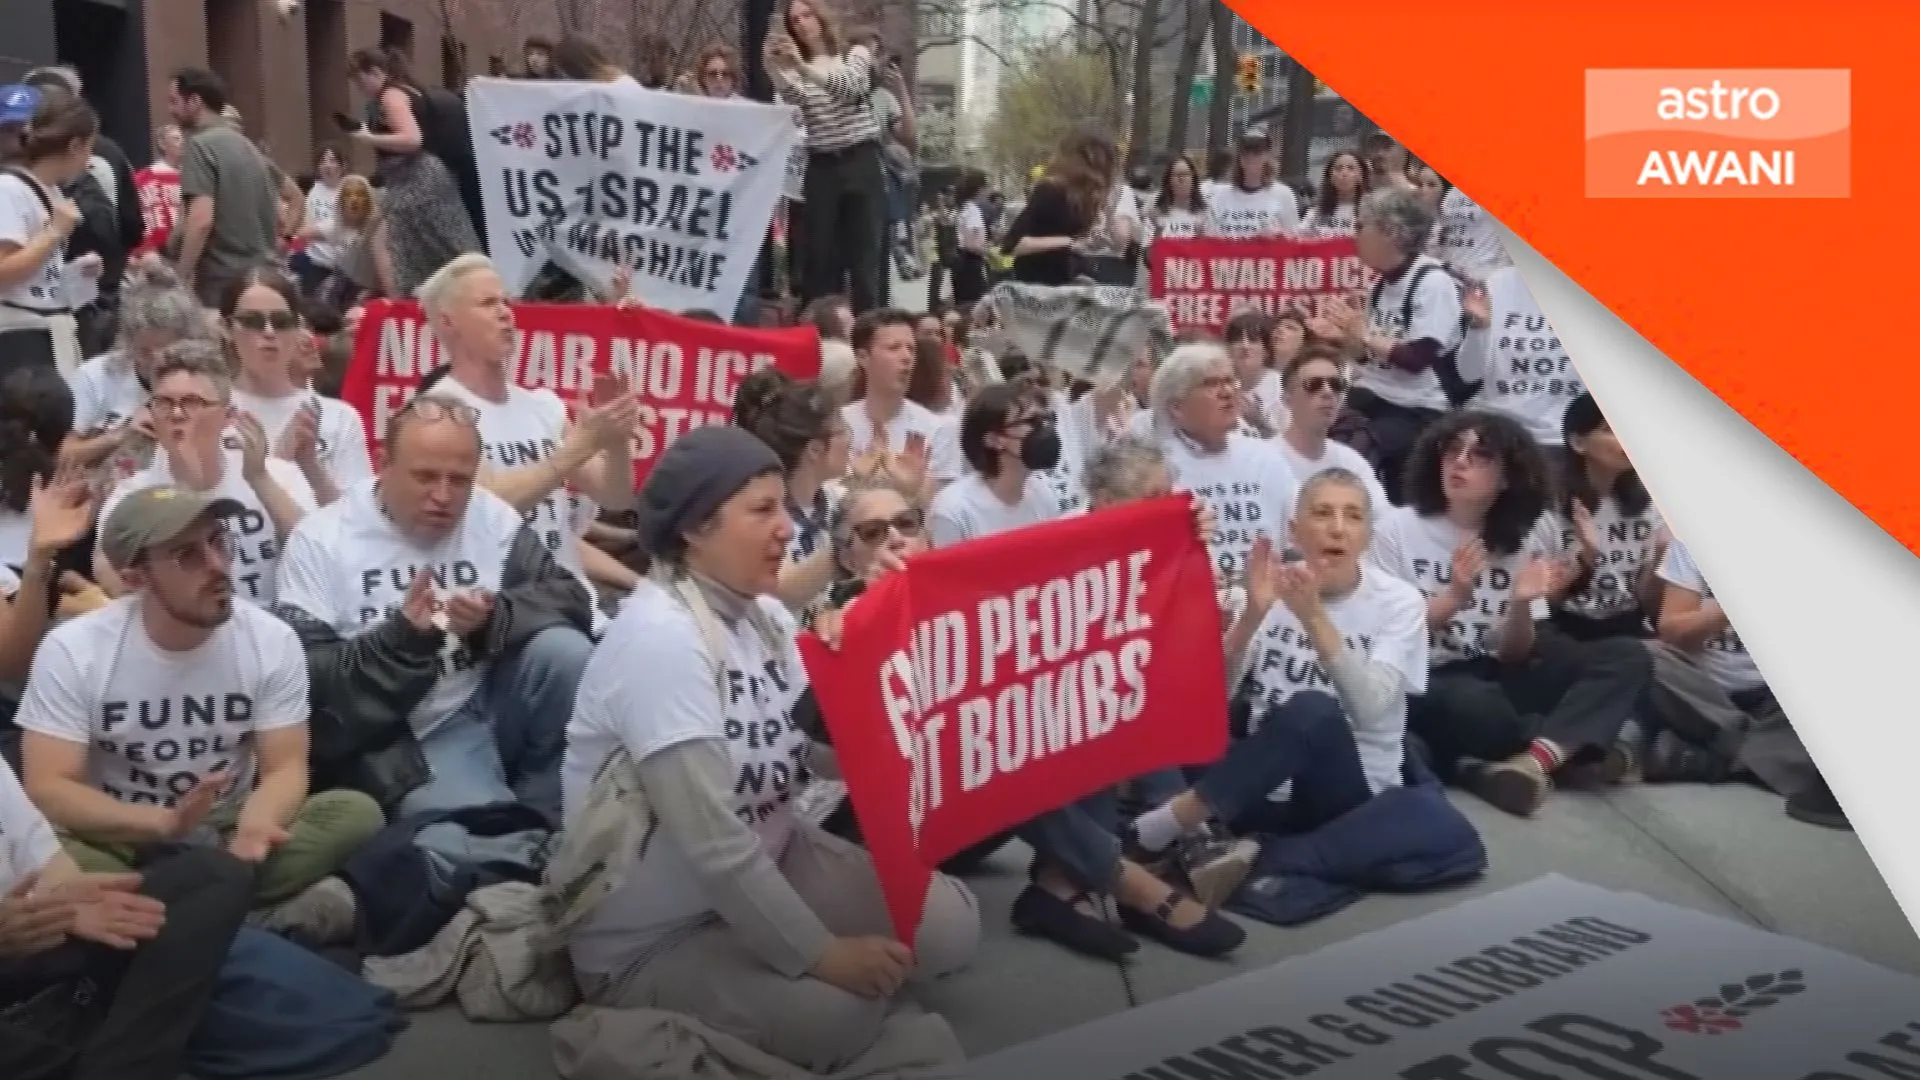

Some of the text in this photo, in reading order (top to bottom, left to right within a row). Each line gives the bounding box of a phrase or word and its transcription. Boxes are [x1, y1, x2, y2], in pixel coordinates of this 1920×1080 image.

[542, 110, 704, 176] STOP THE
[567, 219, 727, 292] MACHINE
[1163, 256, 1205, 290] NO
[1208, 256, 1277, 291] WAR
[1282, 257, 1325, 290] NO
[608, 337, 684, 400] NO
[1496, 379, 1583, 397] BOMBS
[975, 547, 1153, 687] PEOPLE
[102, 691, 254, 732] FUND
[957, 637, 1153, 793] BOMBS
[1344, 916, 1653, 1028] GILLIBRAND
[1307, 1013, 1394, 1047] &
